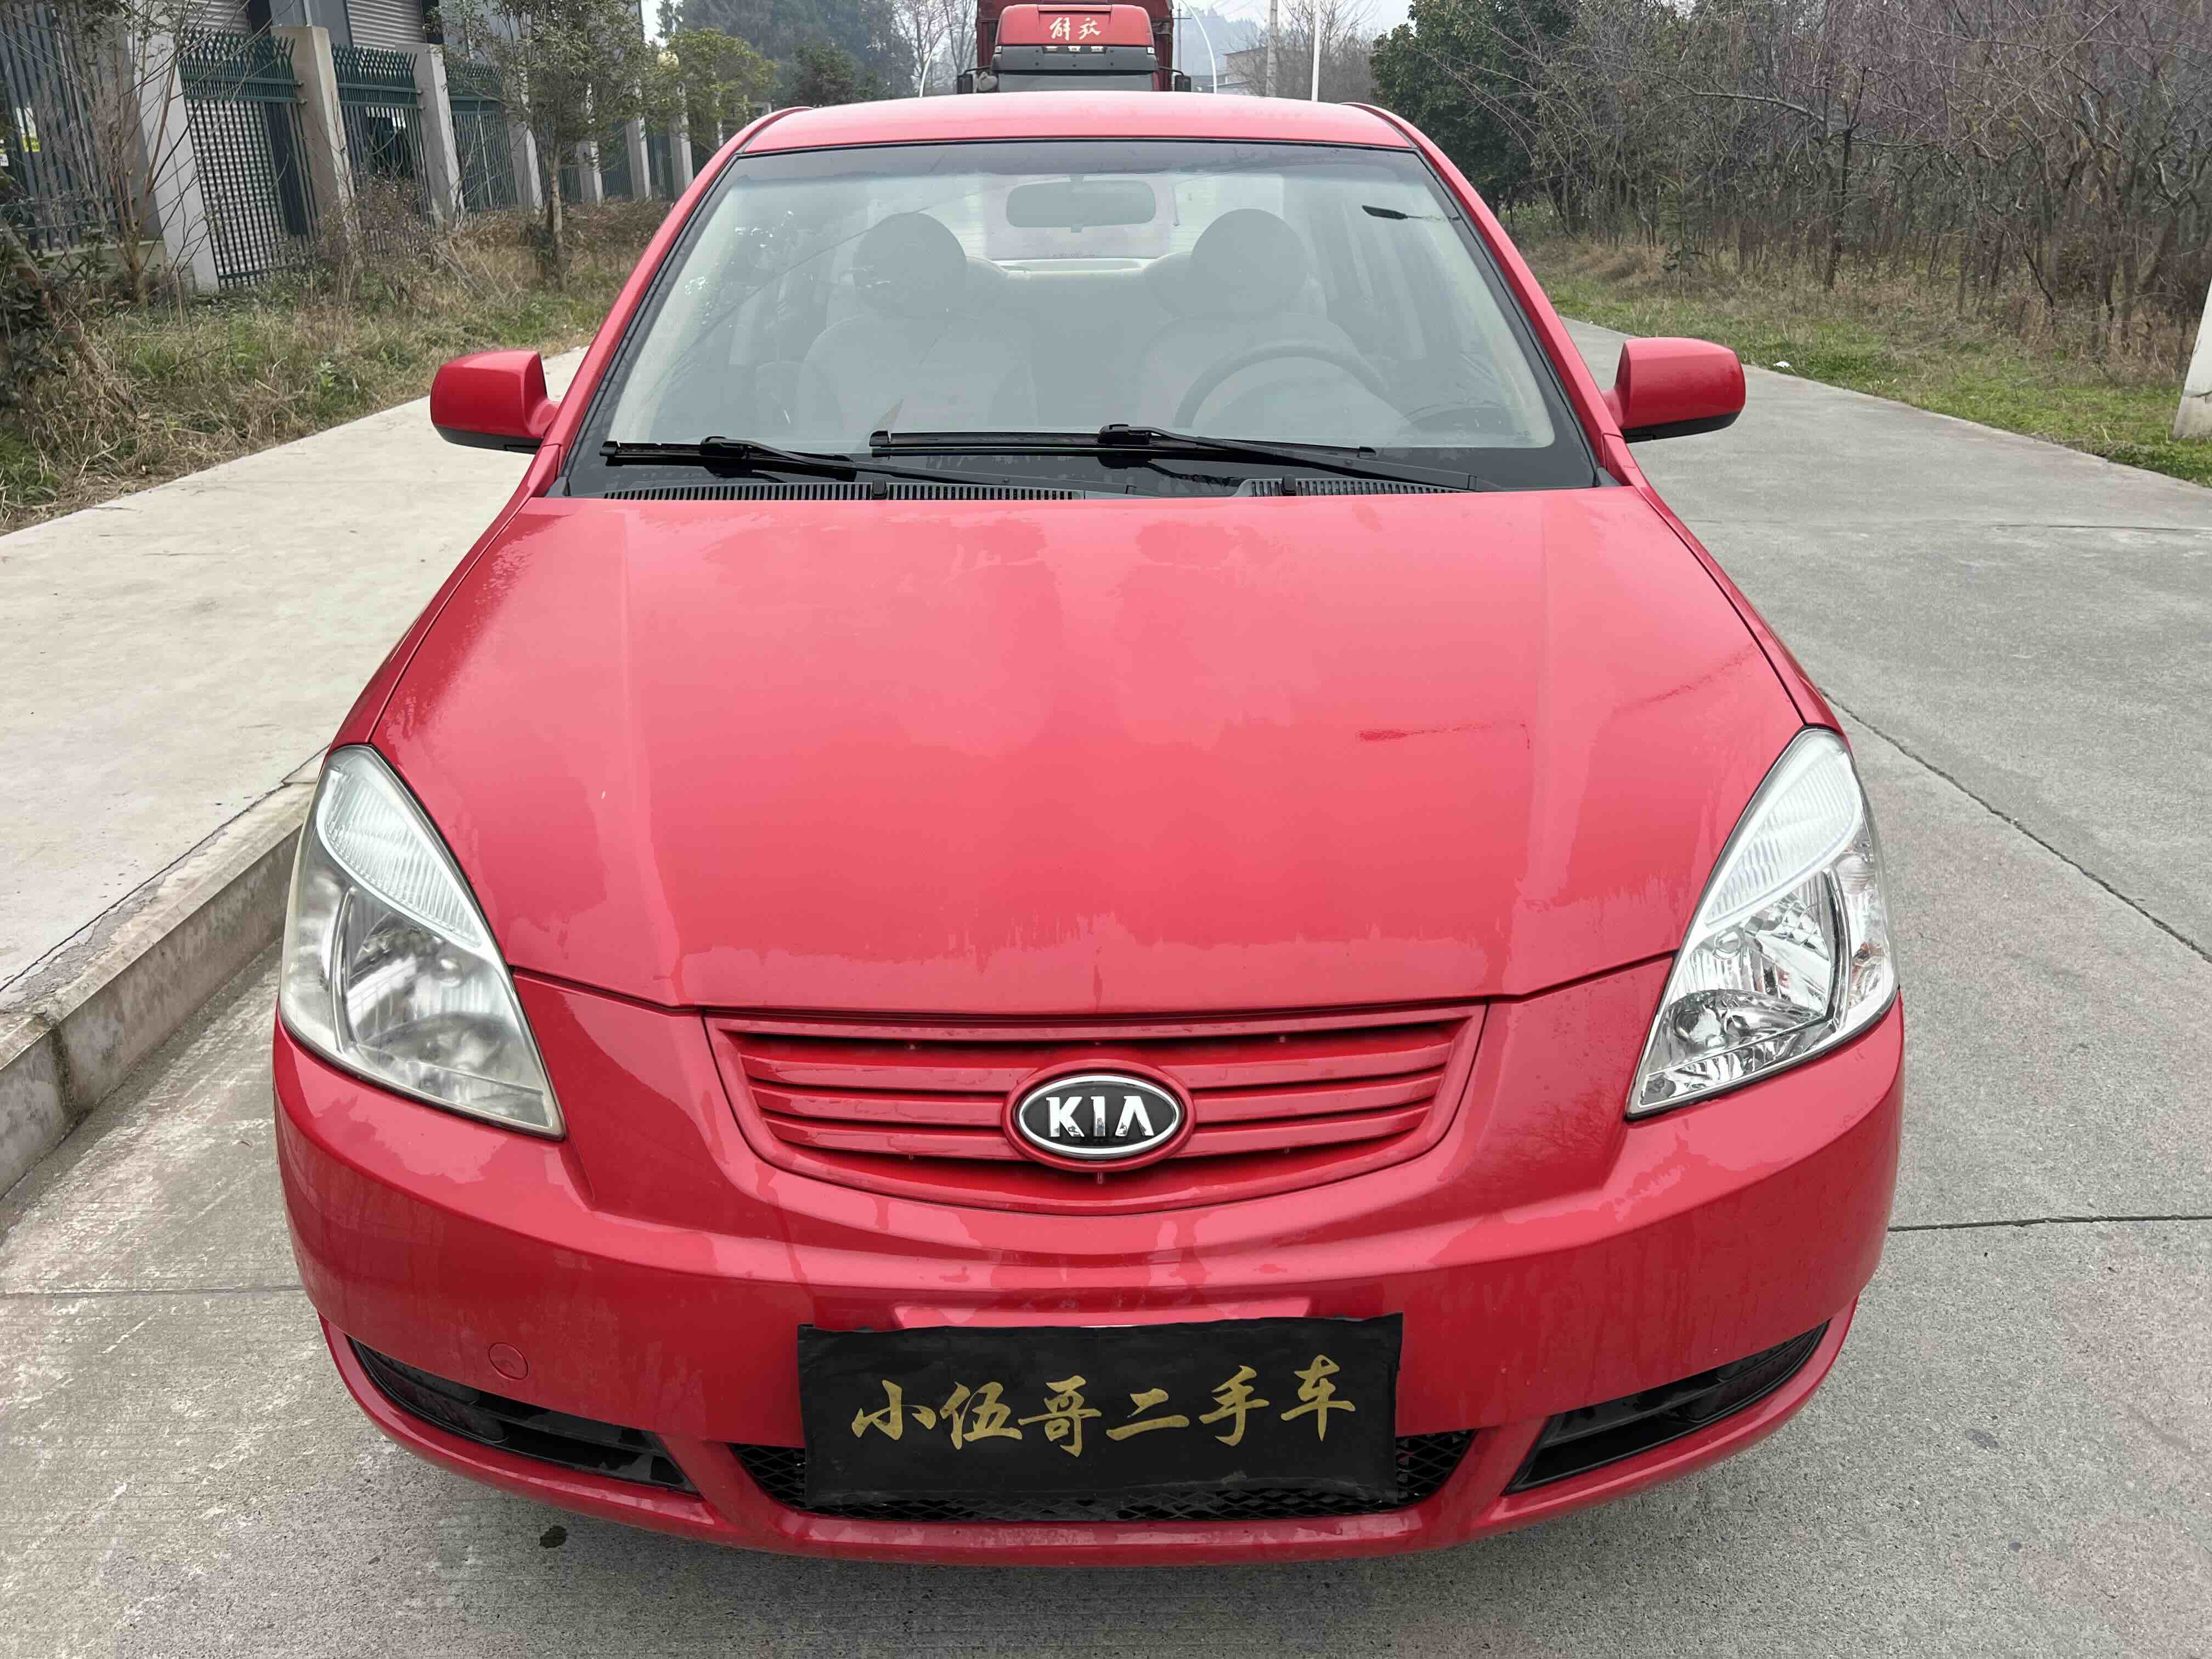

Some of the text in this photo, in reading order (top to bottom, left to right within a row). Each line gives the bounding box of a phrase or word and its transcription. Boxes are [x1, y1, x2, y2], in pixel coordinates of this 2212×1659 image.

[1049, 17, 1101, 41] 解放
[1046, 1096, 1154, 1137] KIA
[851, 1354, 1356, 1457] 小伍哥二手车
